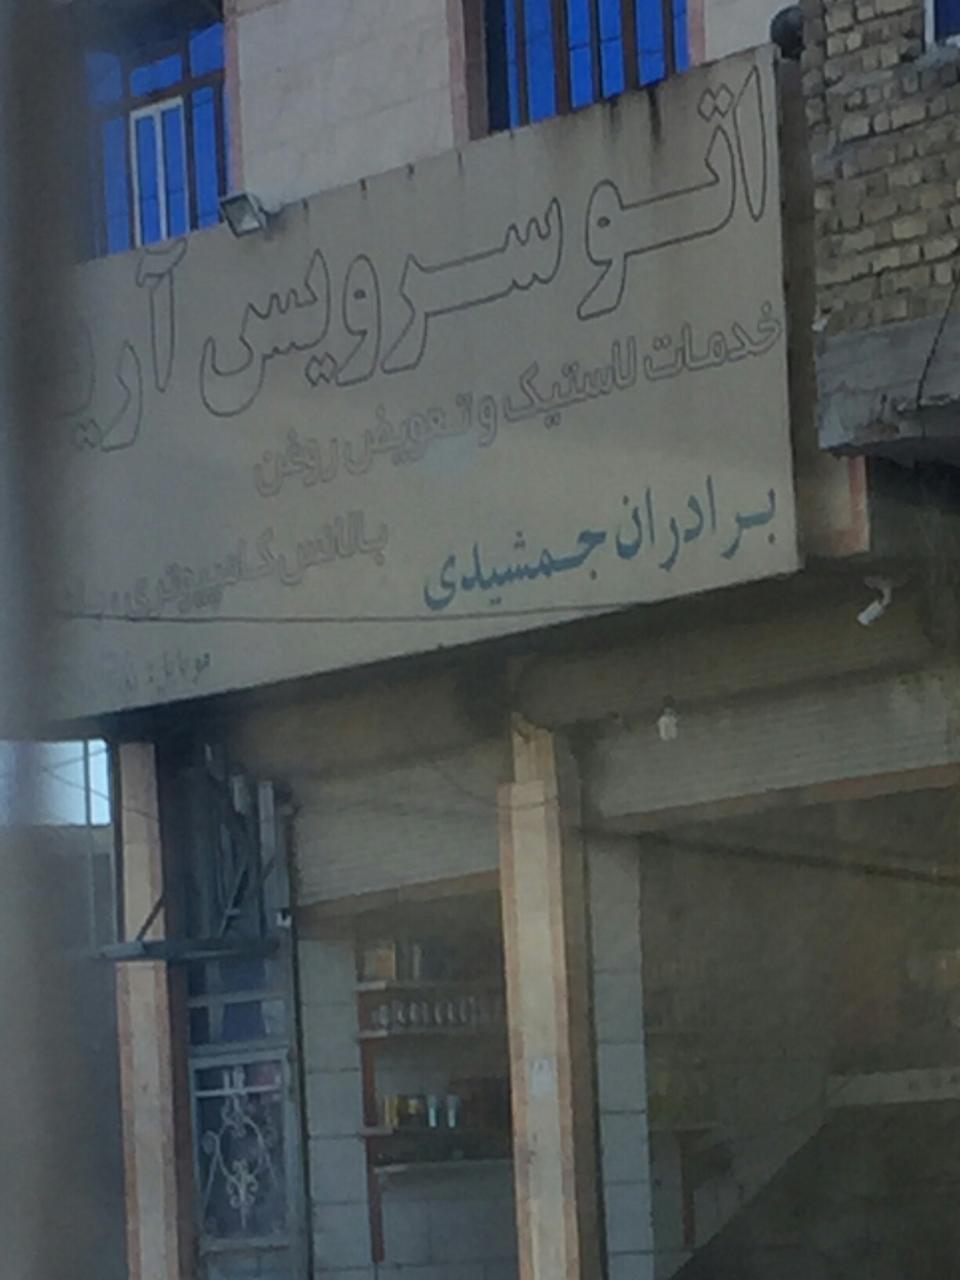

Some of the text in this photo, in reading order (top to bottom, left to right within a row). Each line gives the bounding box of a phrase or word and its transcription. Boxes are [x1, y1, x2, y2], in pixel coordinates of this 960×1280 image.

[502, 325, 638, 430] لاستیک
[643, 299, 783, 379] خدمات
[423, 475, 777, 611] برادران جمشیدی
